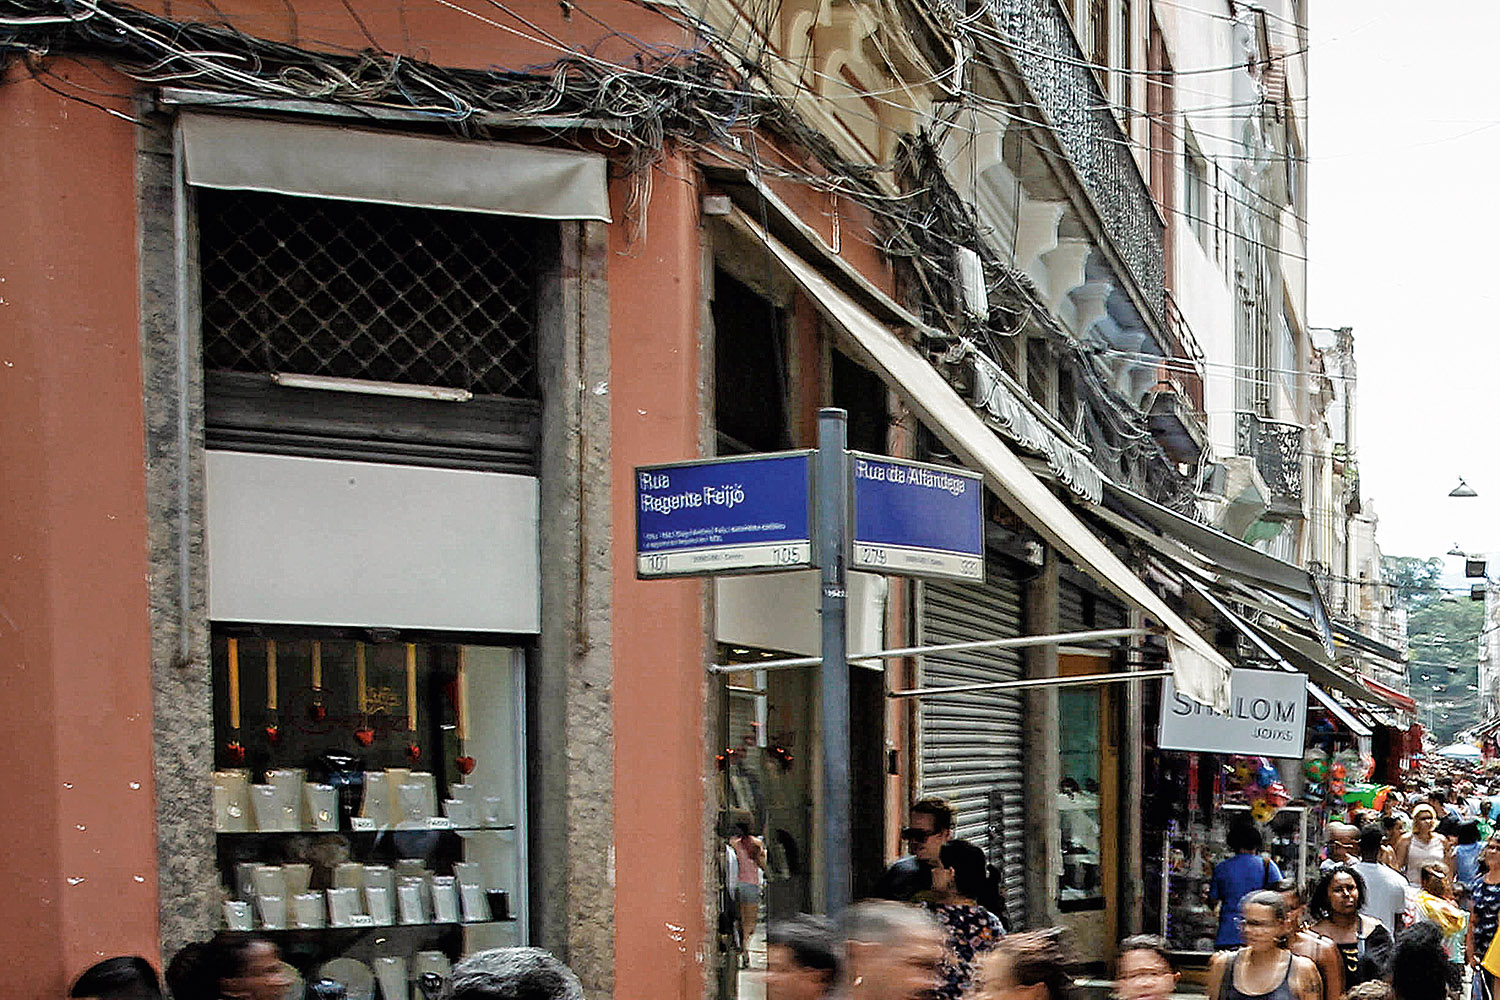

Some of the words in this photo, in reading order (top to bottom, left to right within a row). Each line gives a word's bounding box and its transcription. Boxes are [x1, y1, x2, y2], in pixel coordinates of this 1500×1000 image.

[640, 472, 670, 490] Rua
[856, 460, 885, 480] Rua
[886, 465, 906, 484] da
[641, 492, 702, 515] Regente
[703, 483, 745, 508] Feijó
[648, 556, 668, 571] 101
[773, 547, 800, 565] 105
[1172, 690, 1297, 724] SLOM
